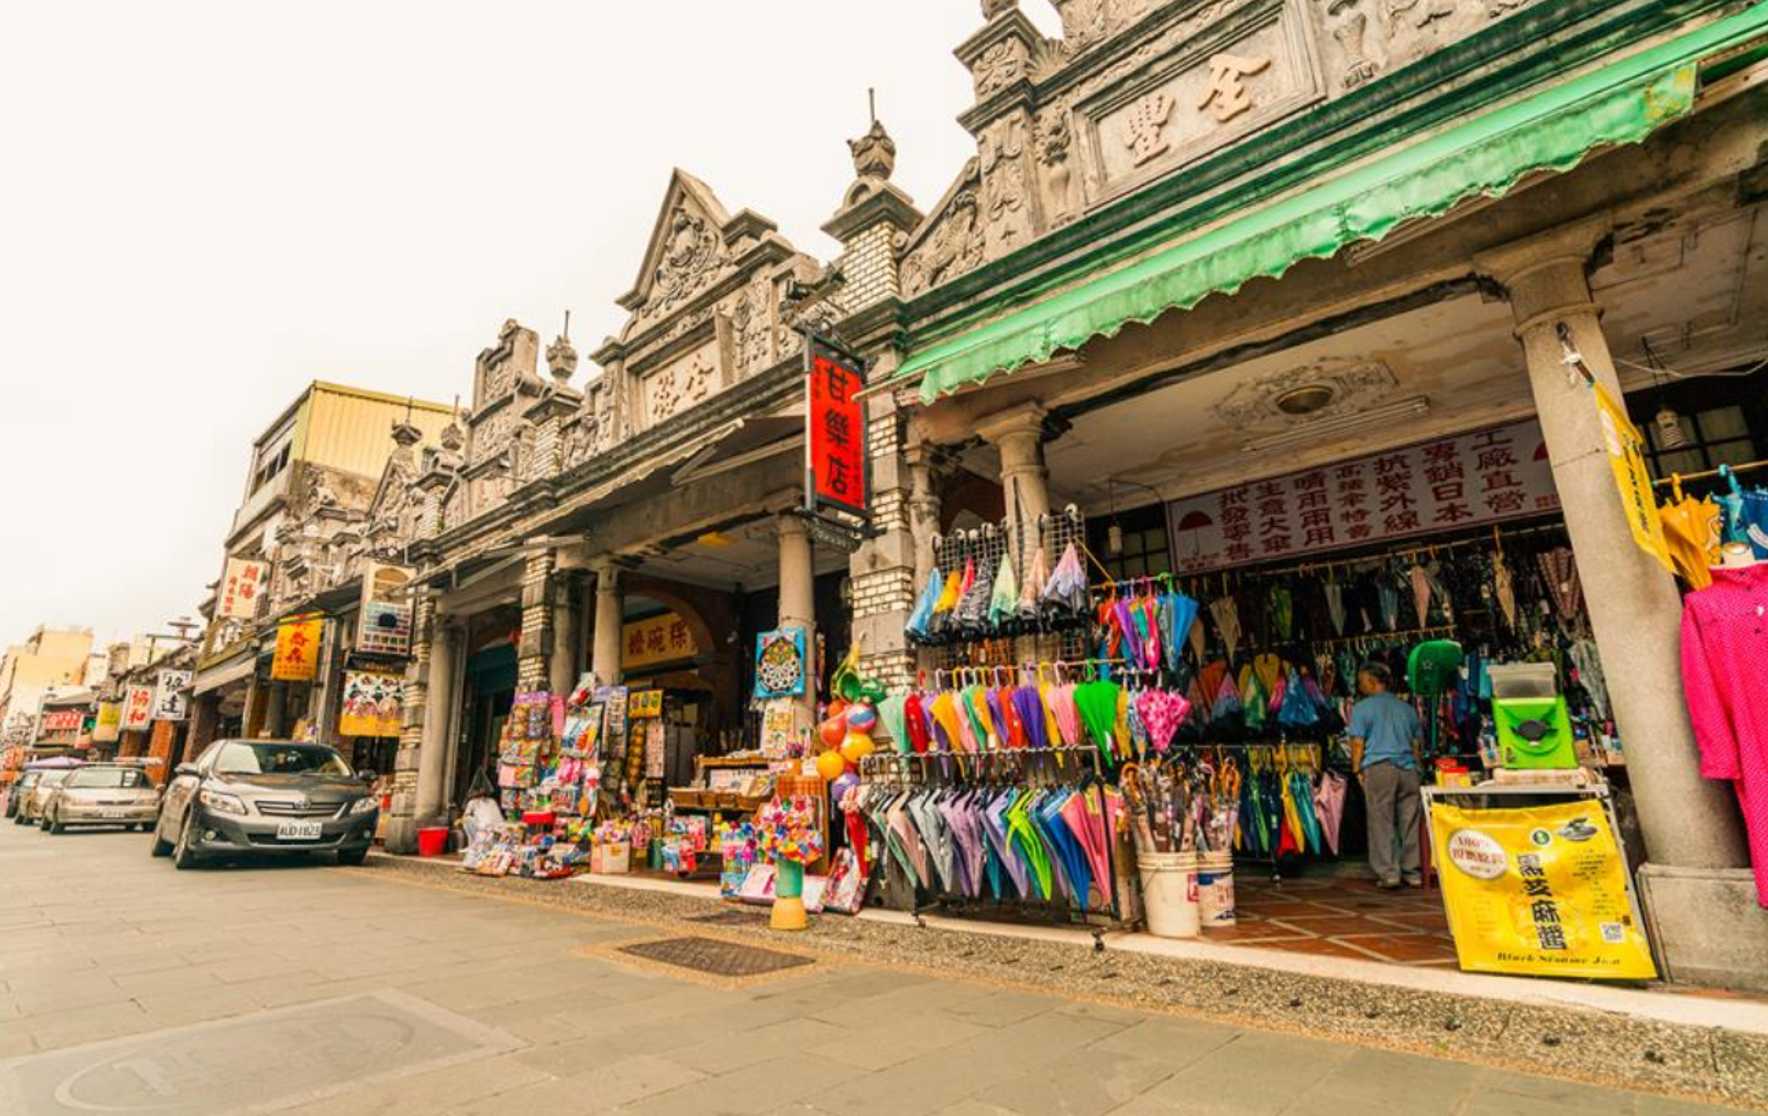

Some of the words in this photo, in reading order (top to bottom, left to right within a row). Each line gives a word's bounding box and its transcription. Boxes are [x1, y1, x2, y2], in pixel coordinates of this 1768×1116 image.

[1373, 453, 1422, 534] 抗紫外線
[1471, 429, 1527, 513] 工廠直營
